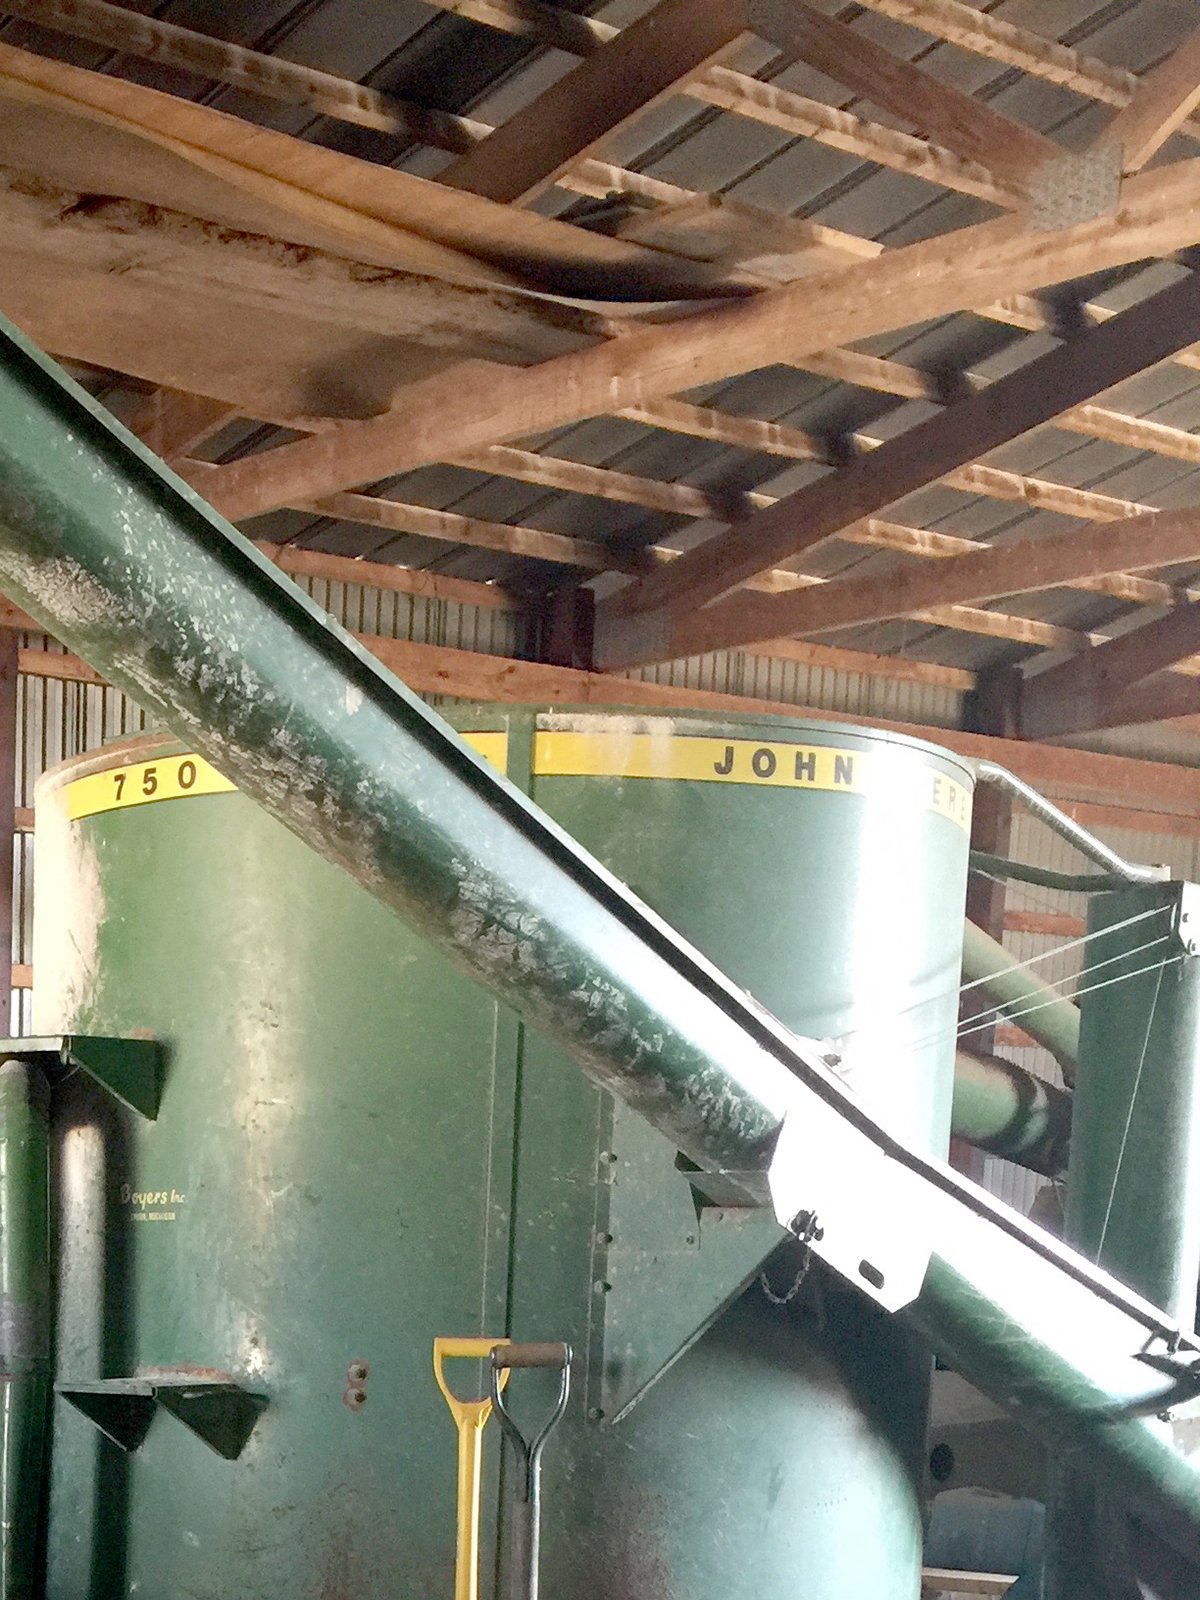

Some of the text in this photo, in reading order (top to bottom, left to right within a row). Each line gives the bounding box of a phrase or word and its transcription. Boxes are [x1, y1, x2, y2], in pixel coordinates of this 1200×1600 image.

[114, 761, 196, 801] 750
[713, 745, 854, 785] JOHN
[120, 1183, 168, 1211] Boyers
